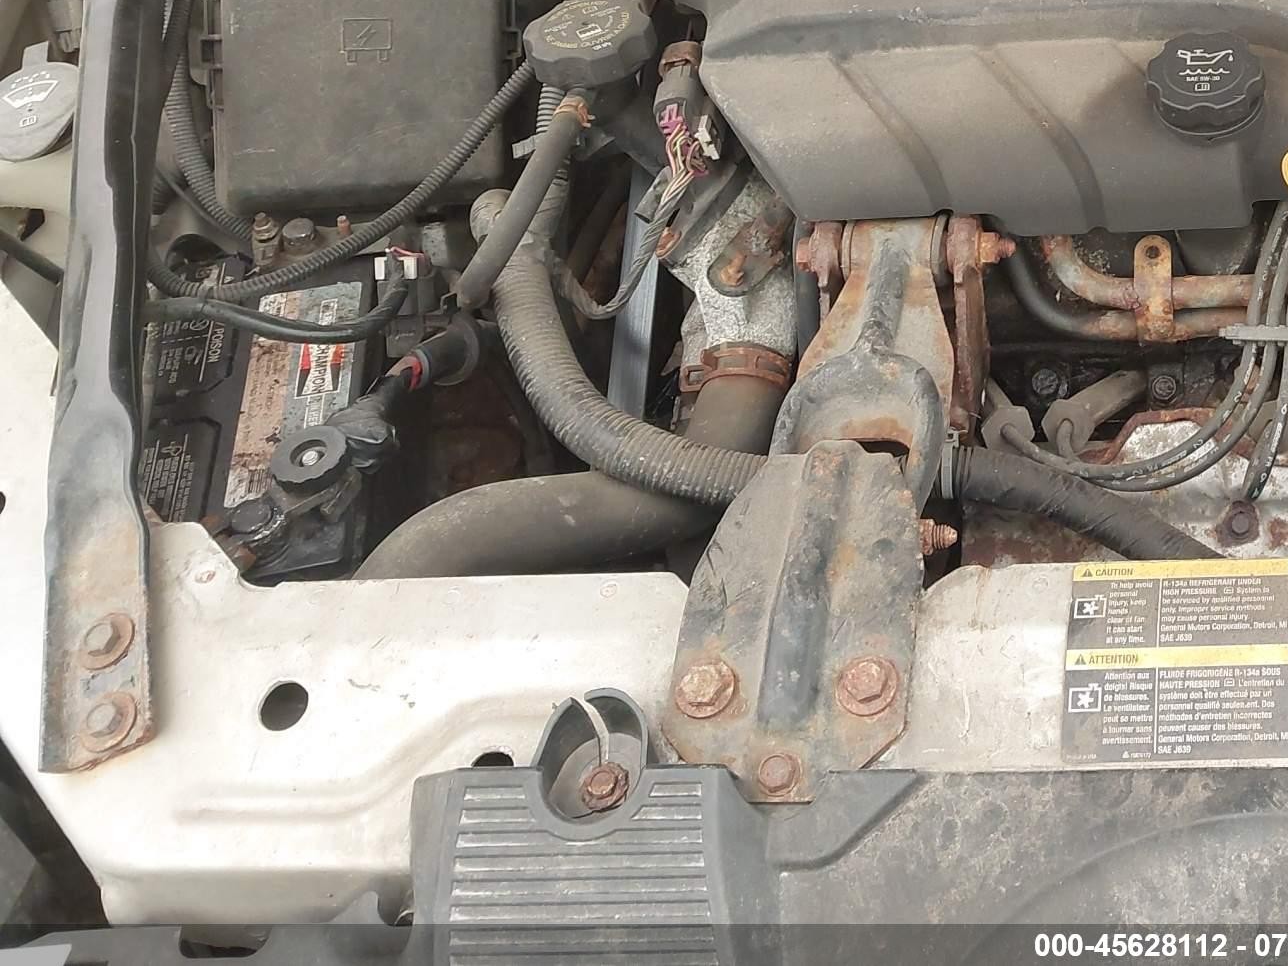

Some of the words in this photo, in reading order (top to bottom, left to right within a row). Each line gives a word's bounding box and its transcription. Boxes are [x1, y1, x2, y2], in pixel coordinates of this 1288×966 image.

[207, 328, 225, 363] POISON
[311, 343, 330, 394] CHAMPION
[1096, 568, 1133, 576] CAUTION
[1089, 654, 1138, 664] ATTENTION
